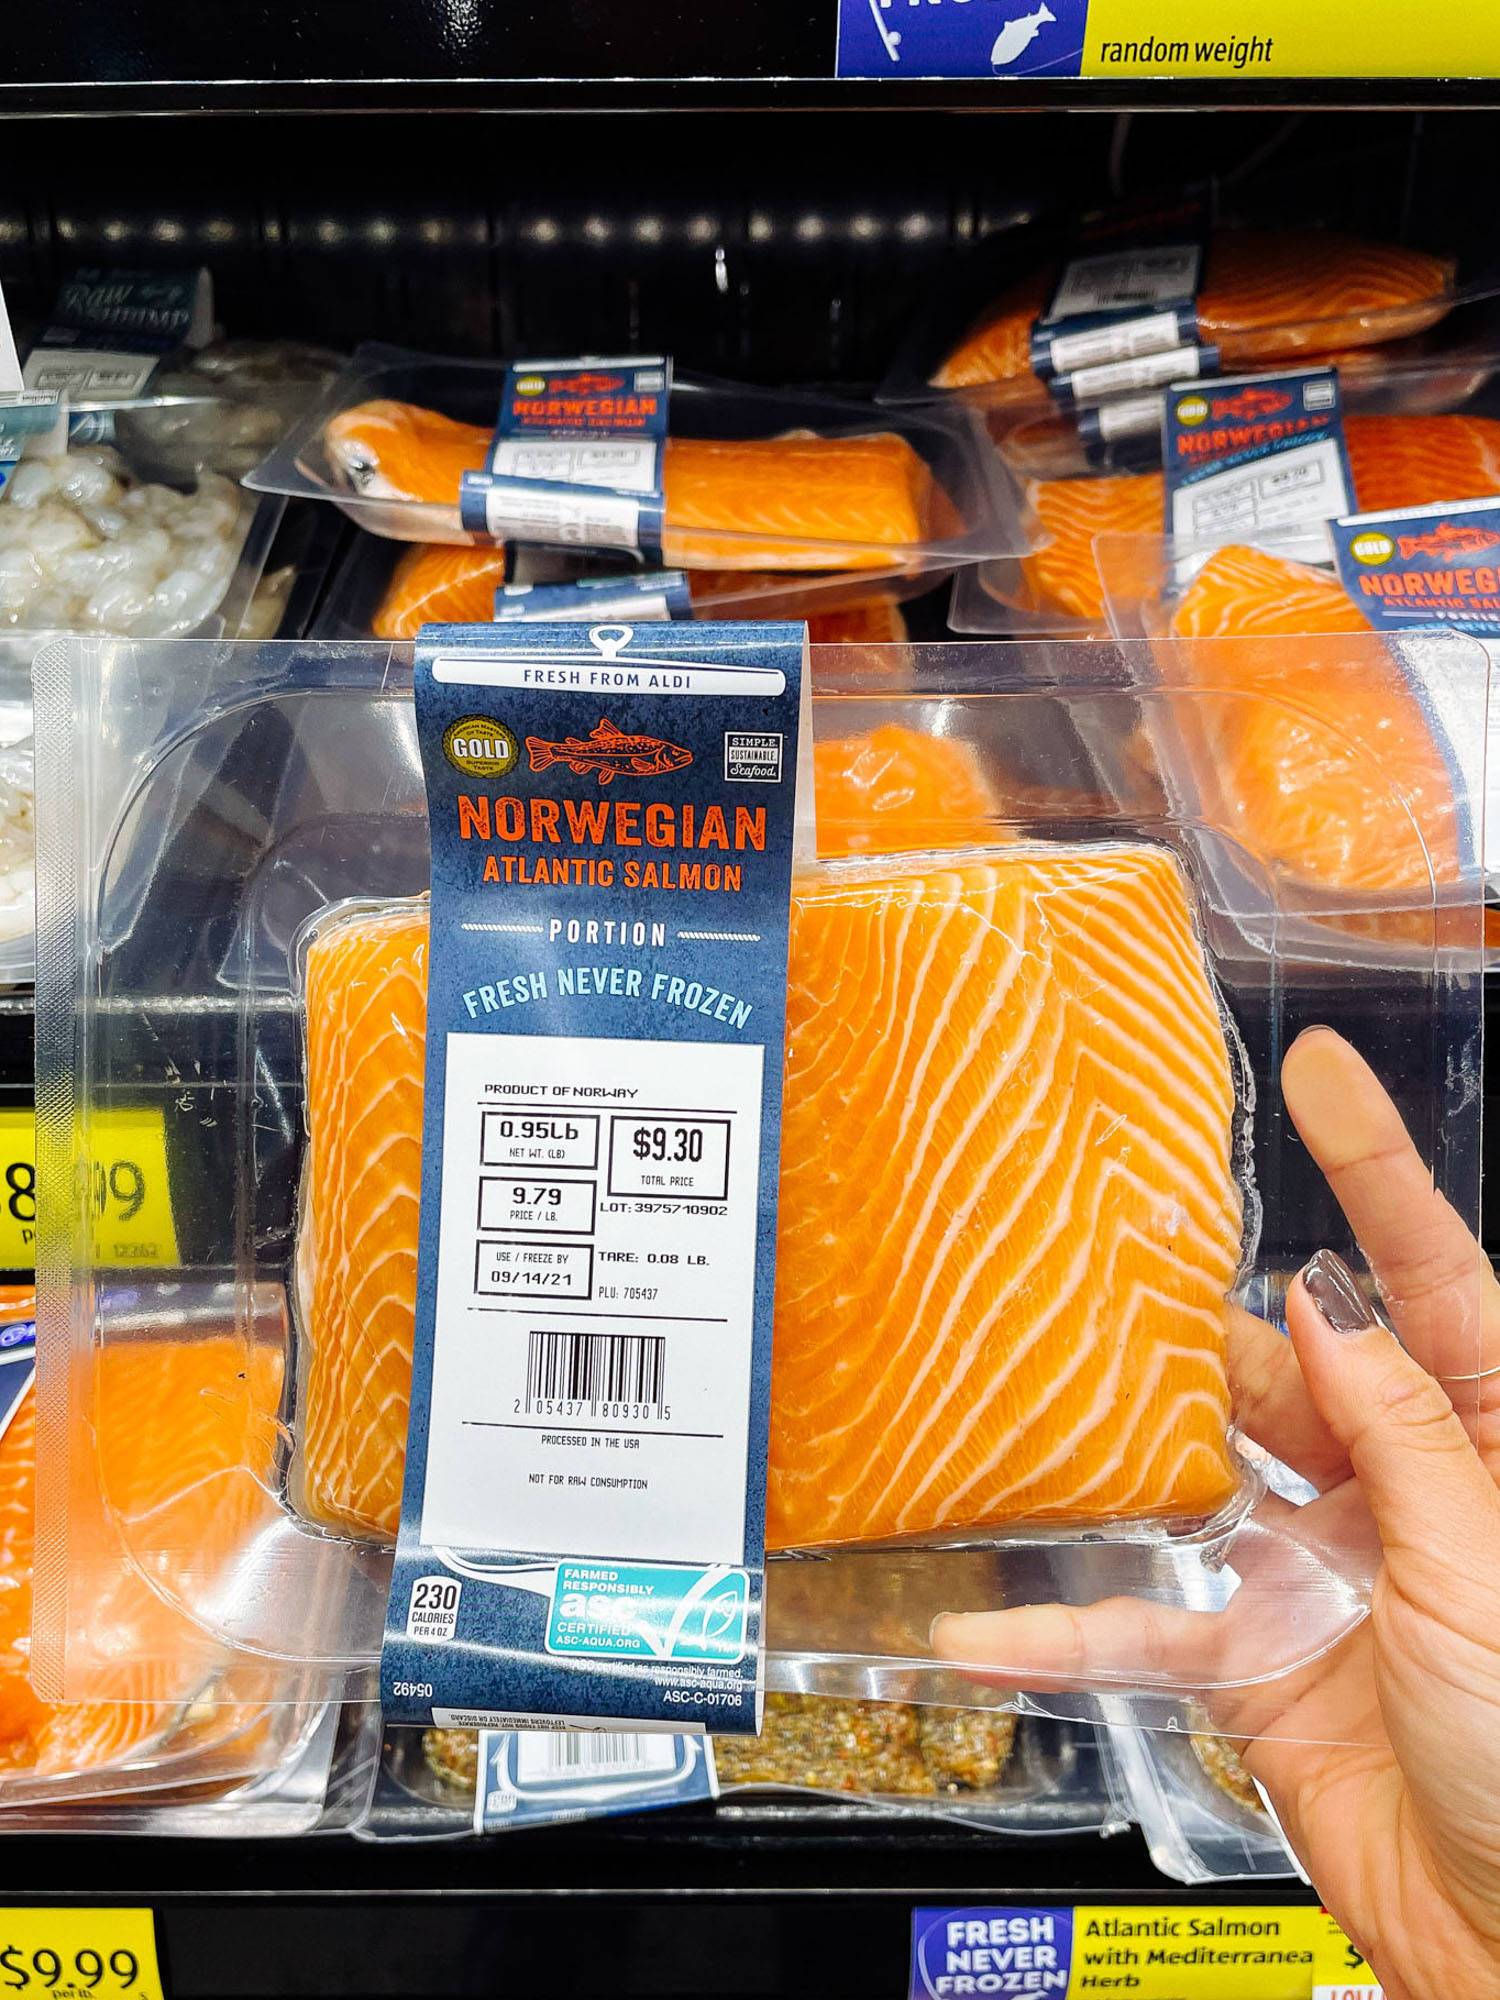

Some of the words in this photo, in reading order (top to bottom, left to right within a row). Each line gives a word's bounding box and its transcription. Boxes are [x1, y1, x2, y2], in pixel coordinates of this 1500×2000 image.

[1100, 36, 1188, 63] random
[1195, 36, 1274, 69] weight
[1359, 567, 1500, 596] NORWEG
[524, 669, 580, 684] FRESH
[590, 672, 639, 687] FROM
[649, 675, 690, 689] ALDI
[453, 738, 509, 759] GOLD
[457, 795, 767, 851] NORWEGIAN
[483, 855, 614, 887] ATLANTIC
[624, 860, 742, 892] SALMON
[549, 918, 666, 946] PORTION
[462, 971, 548, 1019] FRESH
[557, 967, 643, 997] NEVER
[651, 972, 753, 1030] FROZEN
[484, 1084, 548, 1096] PRODUCT
[552, 1086, 570, 1096] OF
[573, 1087, 638, 1098] NORWAY
[633, 1126, 703, 1162] $9.30
[509, 1147, 527, 1158] NET
[529, 1148, 545, 1159] WT.
[548, 1149, 566, 1160] (LB)
[640, 1175, 666, 1187] TOTAL
[670, 1176, 694, 1187] PRICE
[512, 1186, 562, 1206] 9.79
[510, 1210, 534, 1221] PRICE
[545, 1211, 559, 1222] LB.
[496, 1251, 513, 1262] USE
[524, 1252, 554, 1264] FREEZE
[557, 1253, 569, 1265] BY
[598, 1251, 639, 1263] TARE:
[647, 1252, 679, 1265] 0.08
[687, 1254, 710, 1266] LB.
[491, 1269, 572, 1286] 09/14/21
[598, 1286, 619, 1299] PLU:
[623, 1287, 658, 1301] 705437
[541, 1434, 587, 1447] PROCESSED
[590, 1436, 601, 1447] IN
[605, 1437, 620, 1449] THE
[623, 1438, 640, 1449] USA
[528, 1473, 545, 1485] NOT
[549, 1474, 564, 1486] FOR
[568, 1475, 587, 1487] RAW
[590, 1476, 648, 1490] CONSUMPTION
[564, 1568, 618, 1581] FARMED
[563, 1580, 655, 1595] RESPONSIBLY
[414, 1583, 457, 1610] 230
[411, 1611, 454, 1624] CALORIES
[413, 1626, 429, 1636] PER
[430, 1627, 435, 1636] 4
[437, 1627, 448, 1637] OZ
[557, 1621, 633, 1637] CERTIFIED
[556, 1636, 641, 1649] ASC-AQUA.ORG
[707, 1667, 744, 1680] farmed.
[393, 1682, 433, 1697] 05492
[655, 1678, 743, 1693] www.asc-aqua.org
[663, 1691, 743, 1706] ASC-C-01706
[946, 1916, 1054, 1948] FRESH
[1086, 1917, 1181, 1937] Atlantic
[1189, 1918, 1280, 1937] Salmon
[946, 1945, 1058, 1974] NEVER
[1084, 1947, 1138, 1965] with
[0, 1945, 139, 1990] $9.99
[936, 1970, 1067, 1995] FROZEN
[1081, 1974, 1141, 1988] Herb
